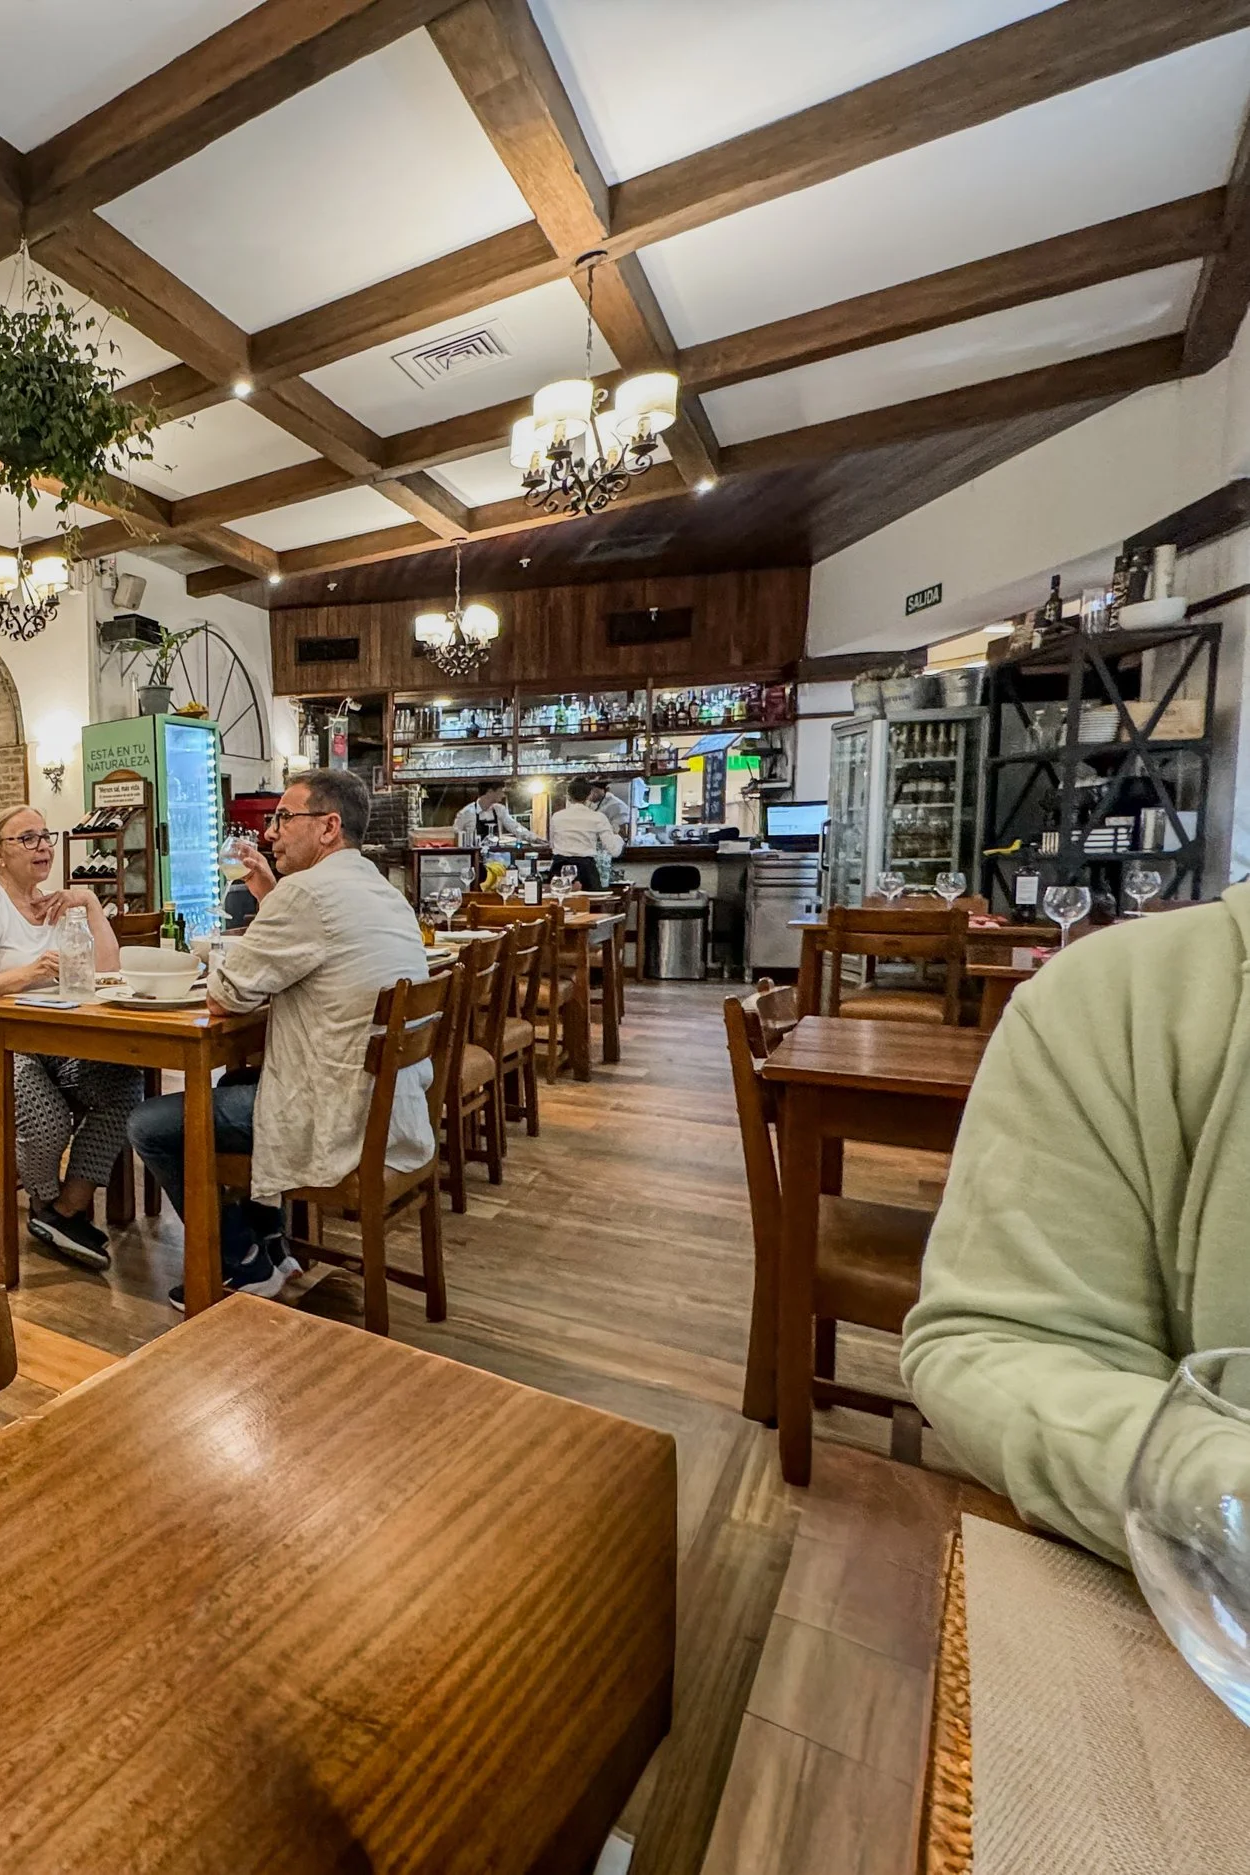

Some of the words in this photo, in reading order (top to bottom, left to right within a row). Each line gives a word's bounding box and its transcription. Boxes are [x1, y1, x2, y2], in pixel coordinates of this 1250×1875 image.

[908, 587, 940, 612] SALIDA
[117, 745, 130, 757] EN
[132, 743, 146, 754] TU
[86, 755, 150, 772] NATURALEZA
